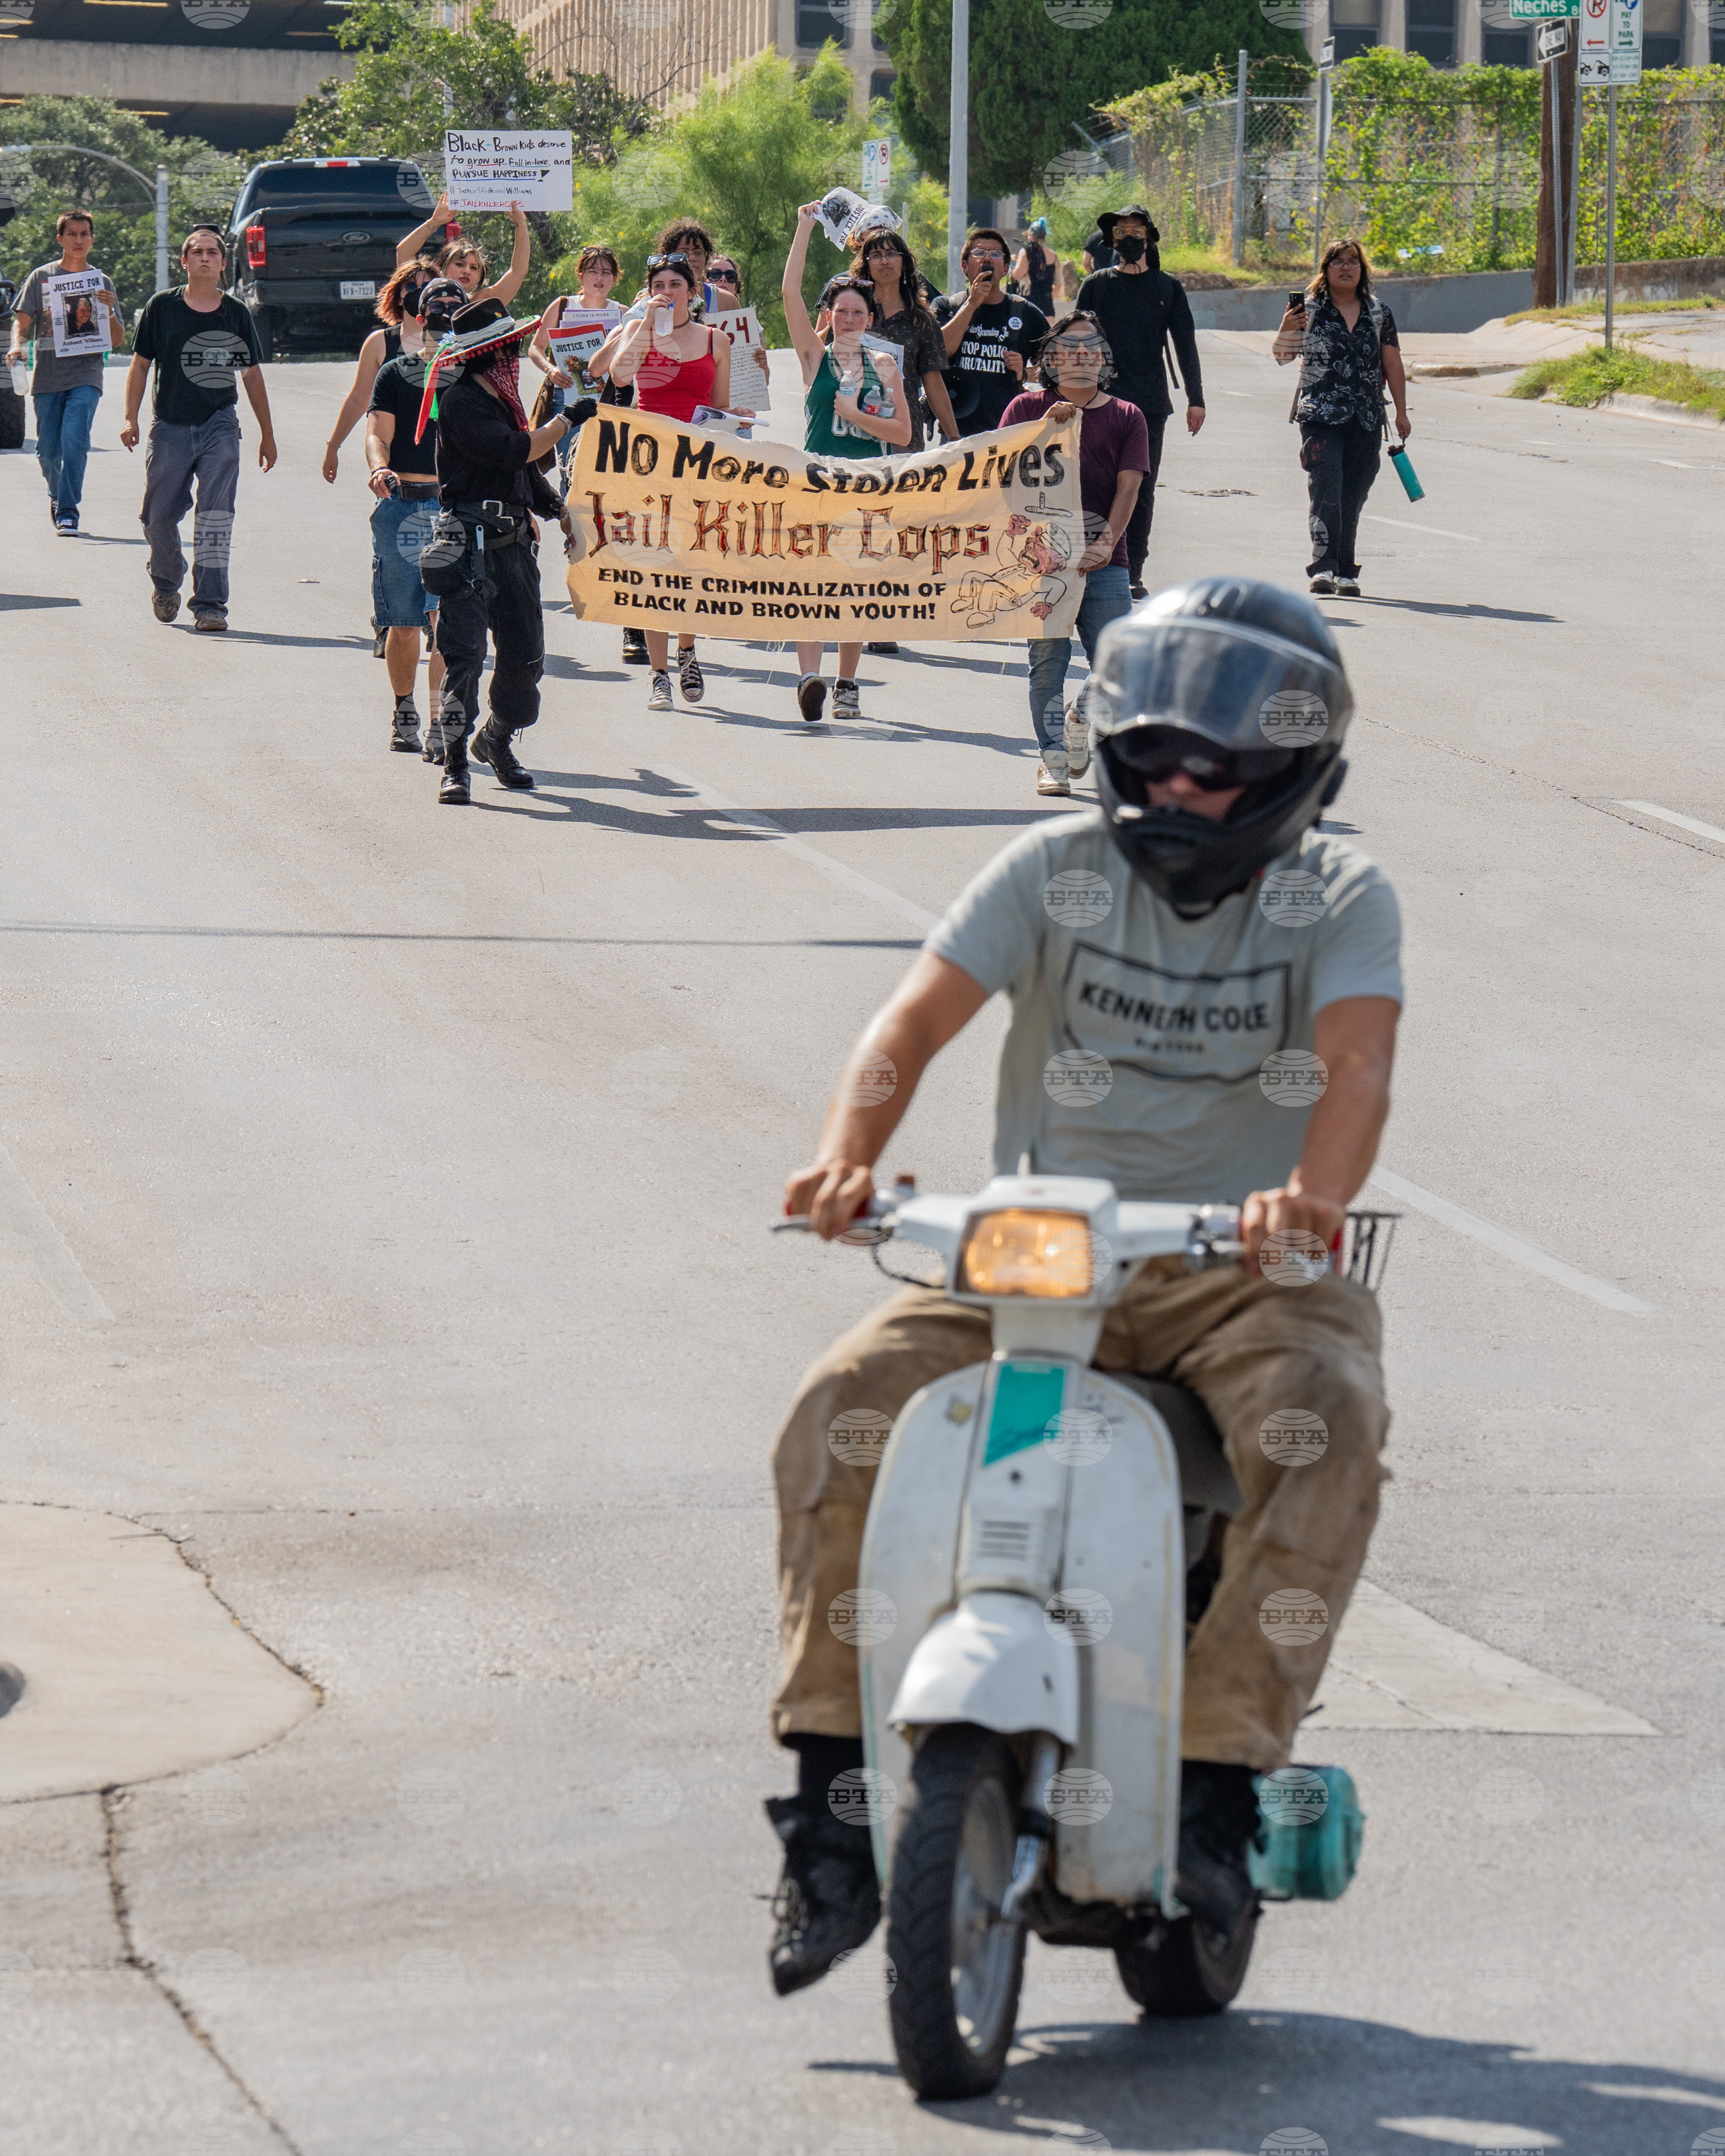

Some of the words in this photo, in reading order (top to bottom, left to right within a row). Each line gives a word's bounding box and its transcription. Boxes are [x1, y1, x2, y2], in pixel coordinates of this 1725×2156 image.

[1514, 0, 1567, 13] Neches
[447, 132, 486, 152] Black
[538, 139, 567, 149] deserve
[450, 155, 464, 164] to
[467, 158, 490, 169] grow
[509, 158, 523, 167] fall
[845, 204, 865, 231] JUSTICE
[839, 231, 848, 245] FOR
[53, 280, 84, 292] JUSTICE
[87, 277, 101, 287] FOR
[556, 341, 584, 353] JUSTICE
[586, 337, 602, 349] FOR
[586, 491, 673, 559] Jail
[692, 495, 843, 560] Killer
[857, 505, 991, 576] Cops
[598, 568, 644, 588] END
[650, 573, 697, 591] THE
[701, 577, 910, 598] CRIMINALIZATION
[918, 582, 947, 598] OF
[613, 591, 687, 614] BLACK
[694, 599, 744, 616] AND
[752, 602, 841, 620] BROWN
[851, 604, 937, 621] YOUTH!
[1204, 1002, 1270, 1033] COLE
